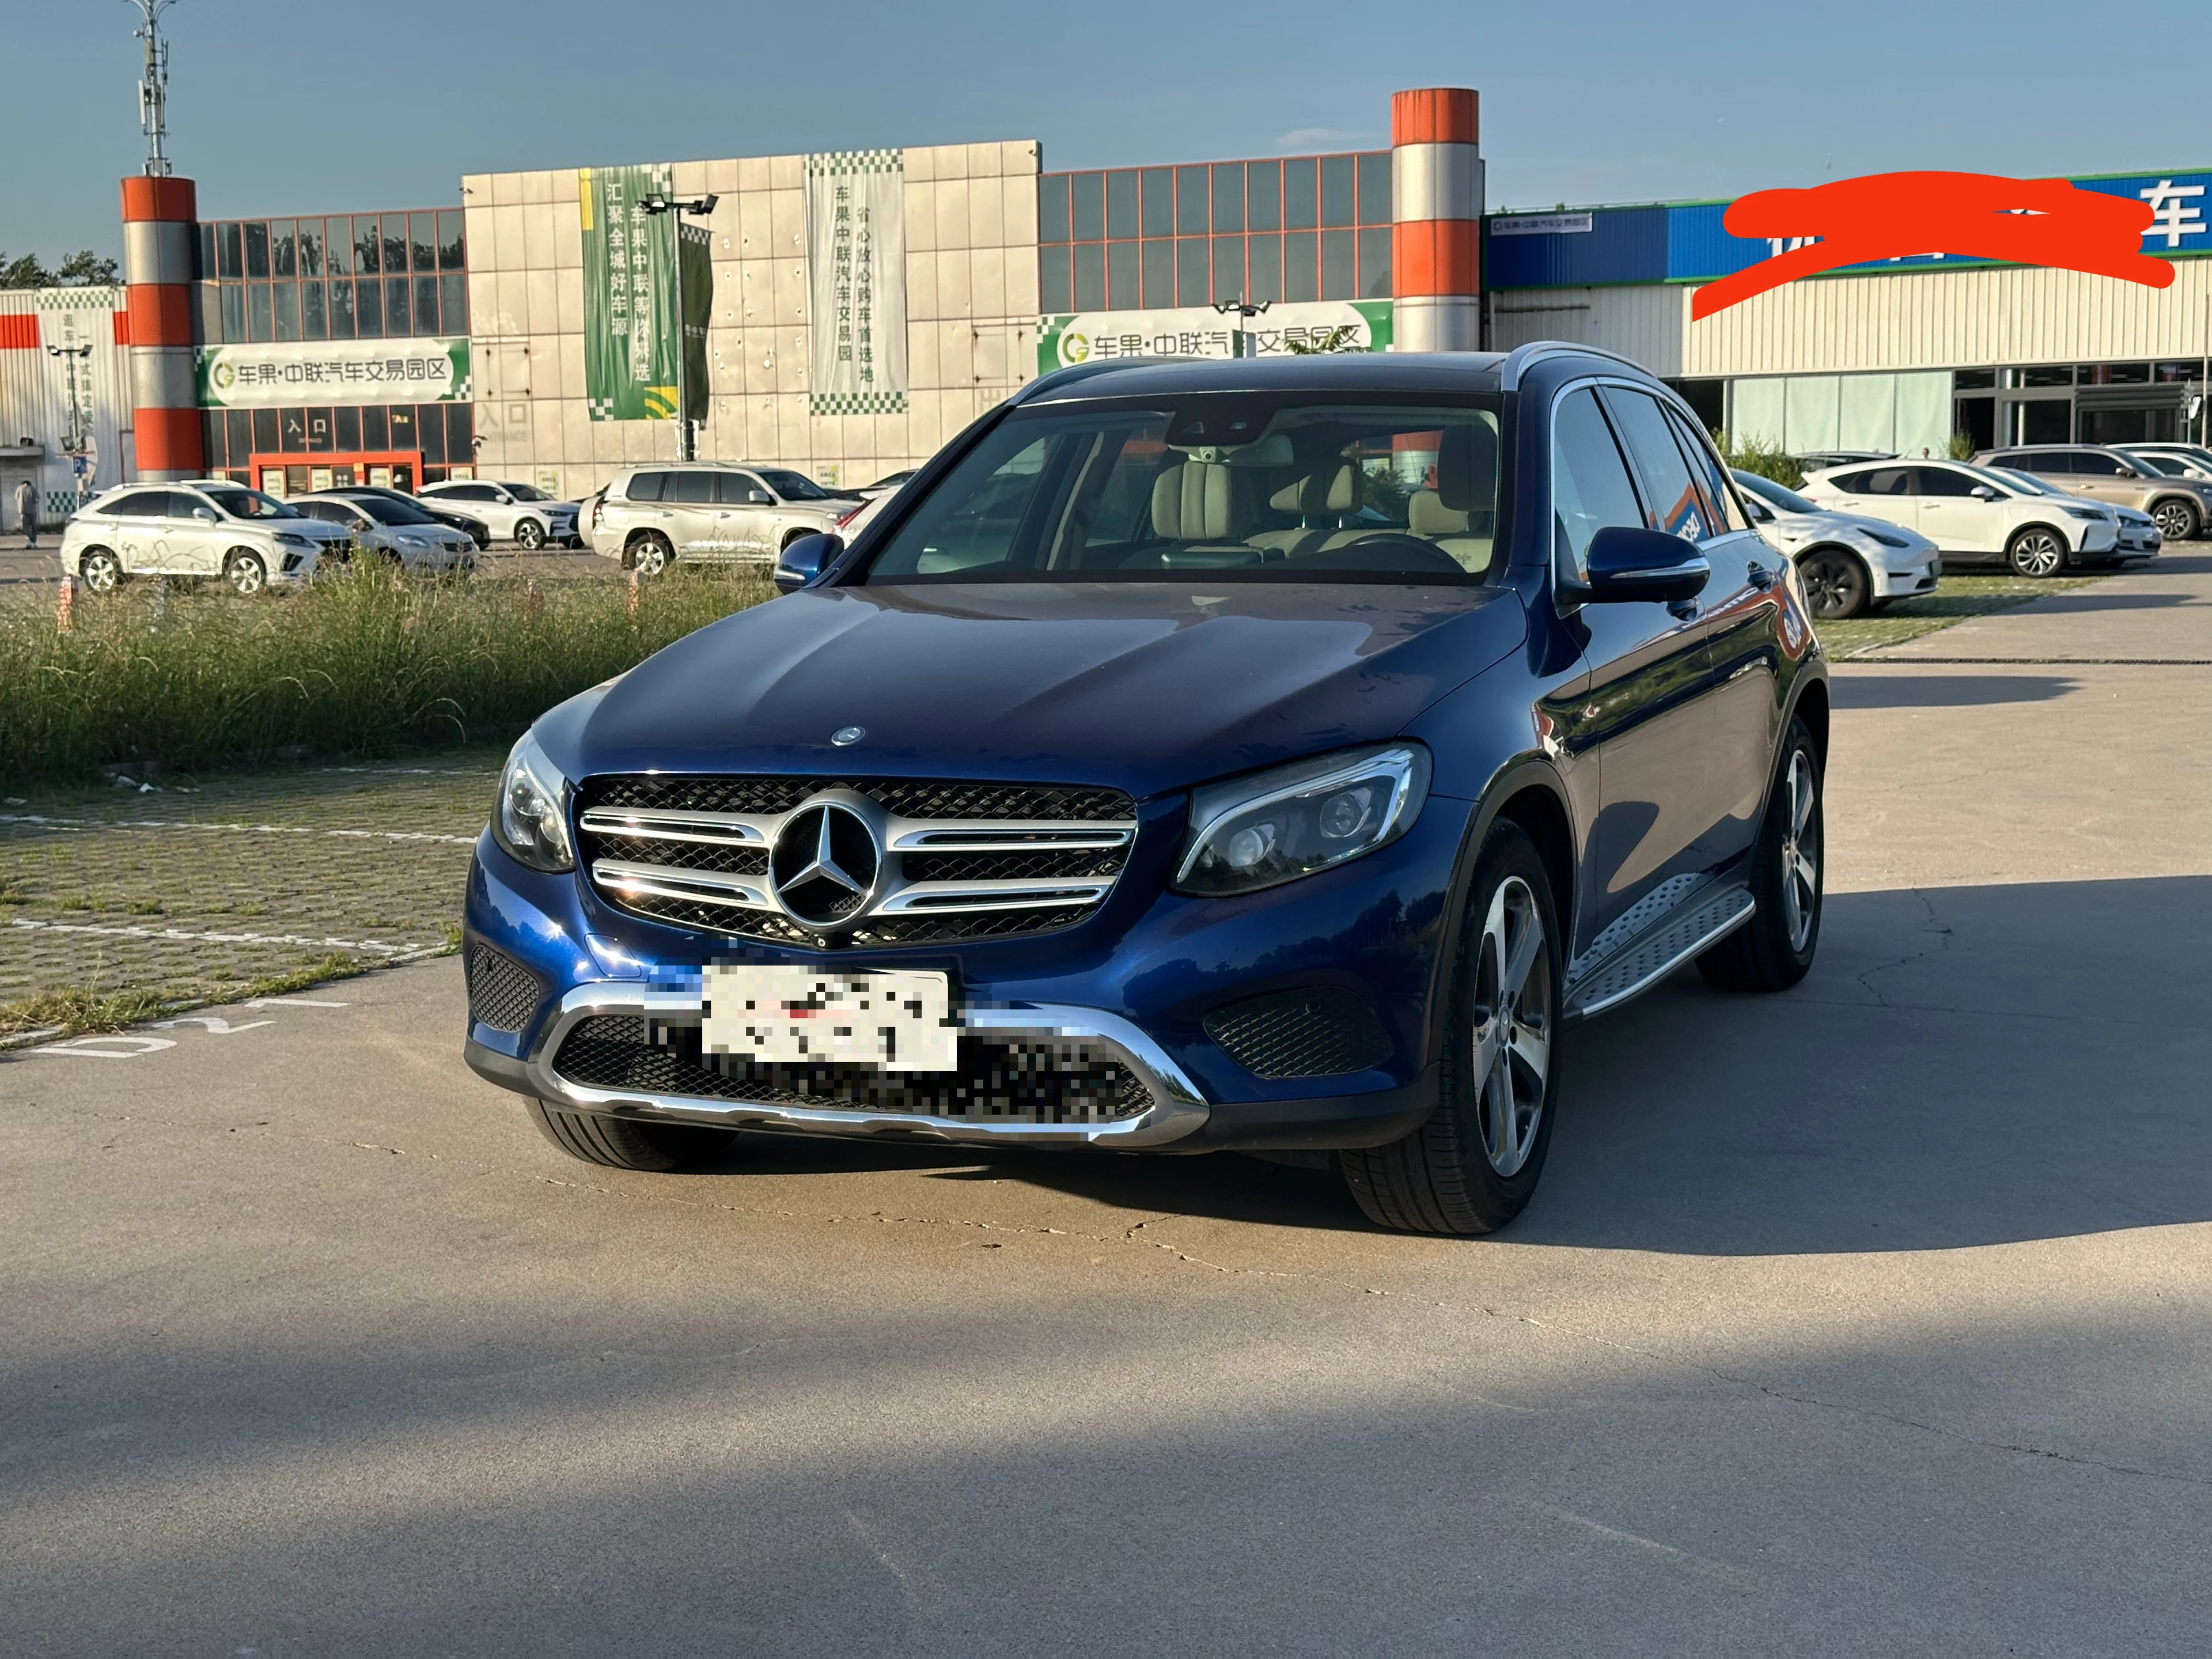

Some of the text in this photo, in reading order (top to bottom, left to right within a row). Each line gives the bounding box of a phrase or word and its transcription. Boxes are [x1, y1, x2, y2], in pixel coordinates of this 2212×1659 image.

[607, 183, 628, 336] 汇聚全城好车源
[835, 185, 852, 362] 车果中联汽车交易园
[857, 207, 874, 382] 省心放心购车首选地
[1094, 324, 1362, 358] 车果·中联汽交易园区
[238, 358, 446, 385] 车果·中联汽车交易园区
[287, 419, 326, 433] 入口
[479, 403, 527, 429] 入口
